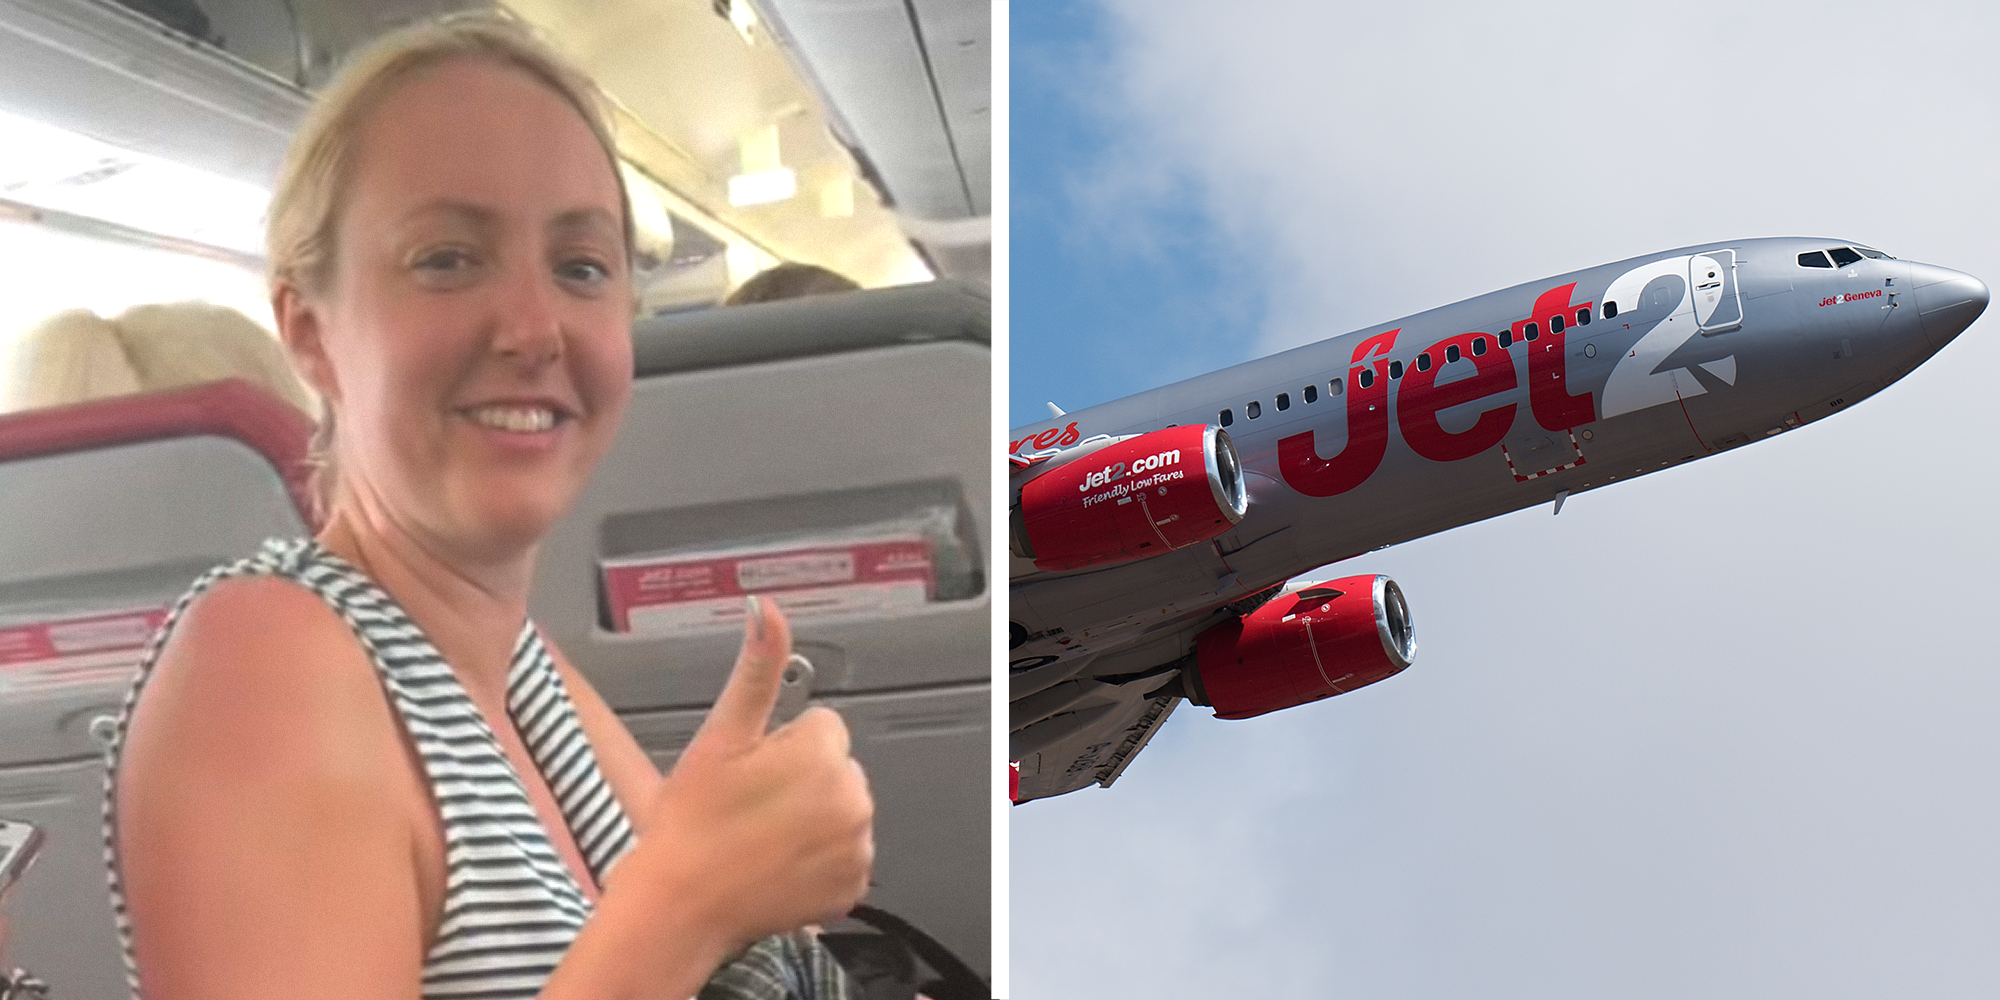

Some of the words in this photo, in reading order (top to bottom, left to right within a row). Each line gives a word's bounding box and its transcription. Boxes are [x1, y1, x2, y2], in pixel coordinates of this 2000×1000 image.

[1277, 255, 1737, 498] jet2
[1082, 484, 1130, 509] Friendly
[1130, 477, 1153, 491] Low
[1152, 470, 1184, 485] Fares
